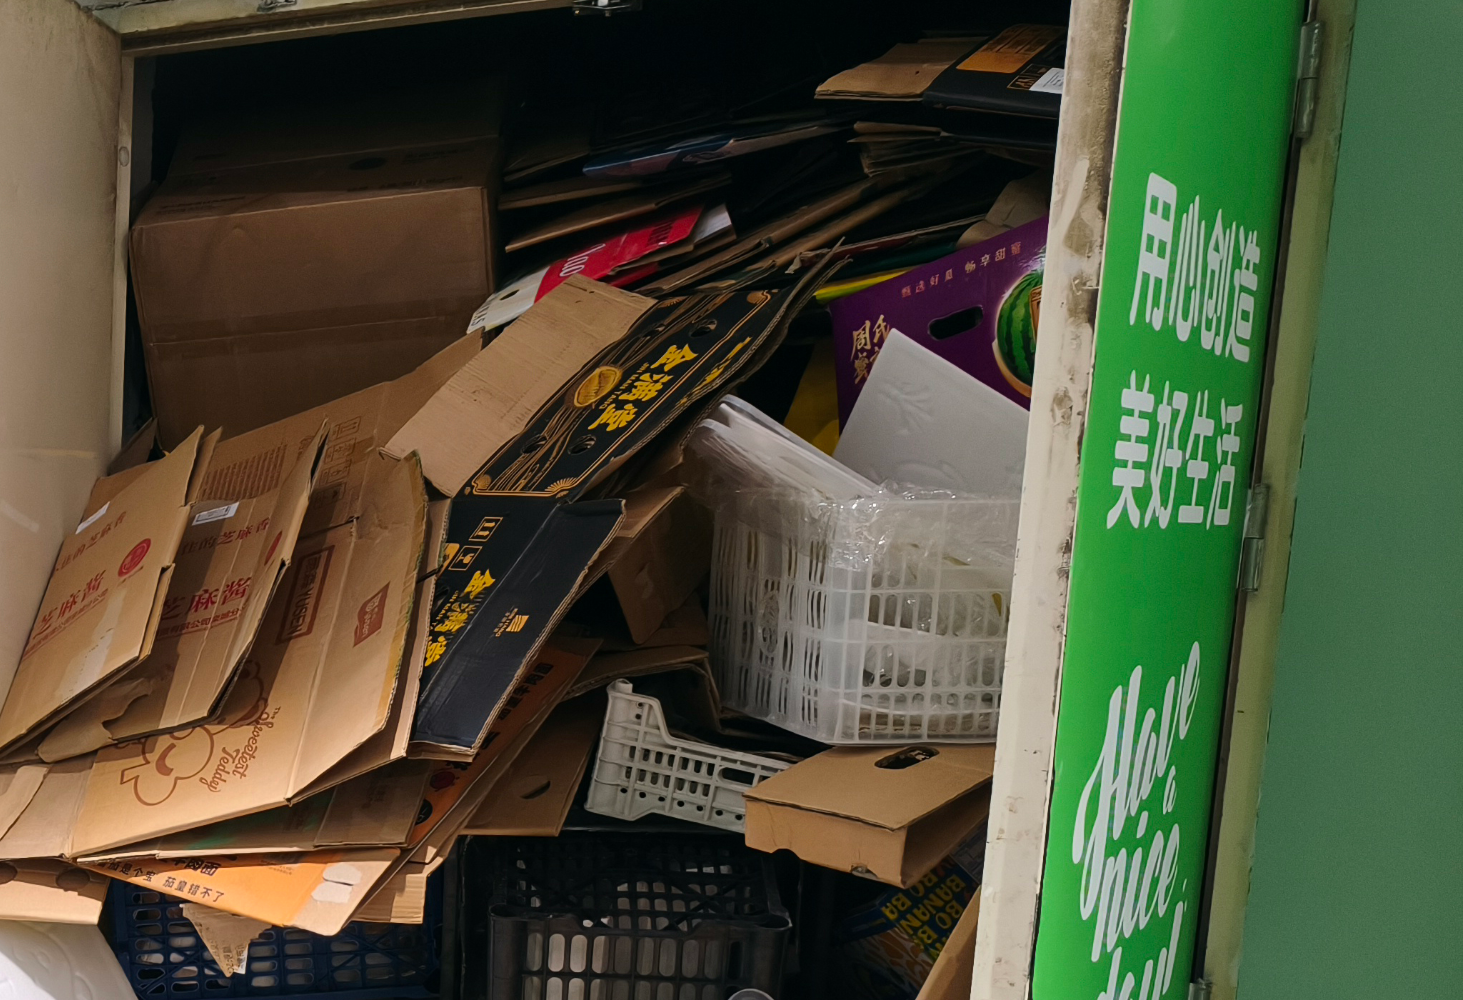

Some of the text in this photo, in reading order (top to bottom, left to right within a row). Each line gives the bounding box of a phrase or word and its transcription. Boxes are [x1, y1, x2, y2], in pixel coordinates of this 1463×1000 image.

[1129, 172, 1261, 363] 用心创造
[1106, 370, 1243, 531] 美好生活
[33, 570, 107, 639] 芝麻酱
[162, 576, 252, 621] 芝麻酱
[199, 747, 241, 792] Teddy
[162, 876, 225, 903] 茄皇错不了
[1091, 810, 1180, 963] nice
